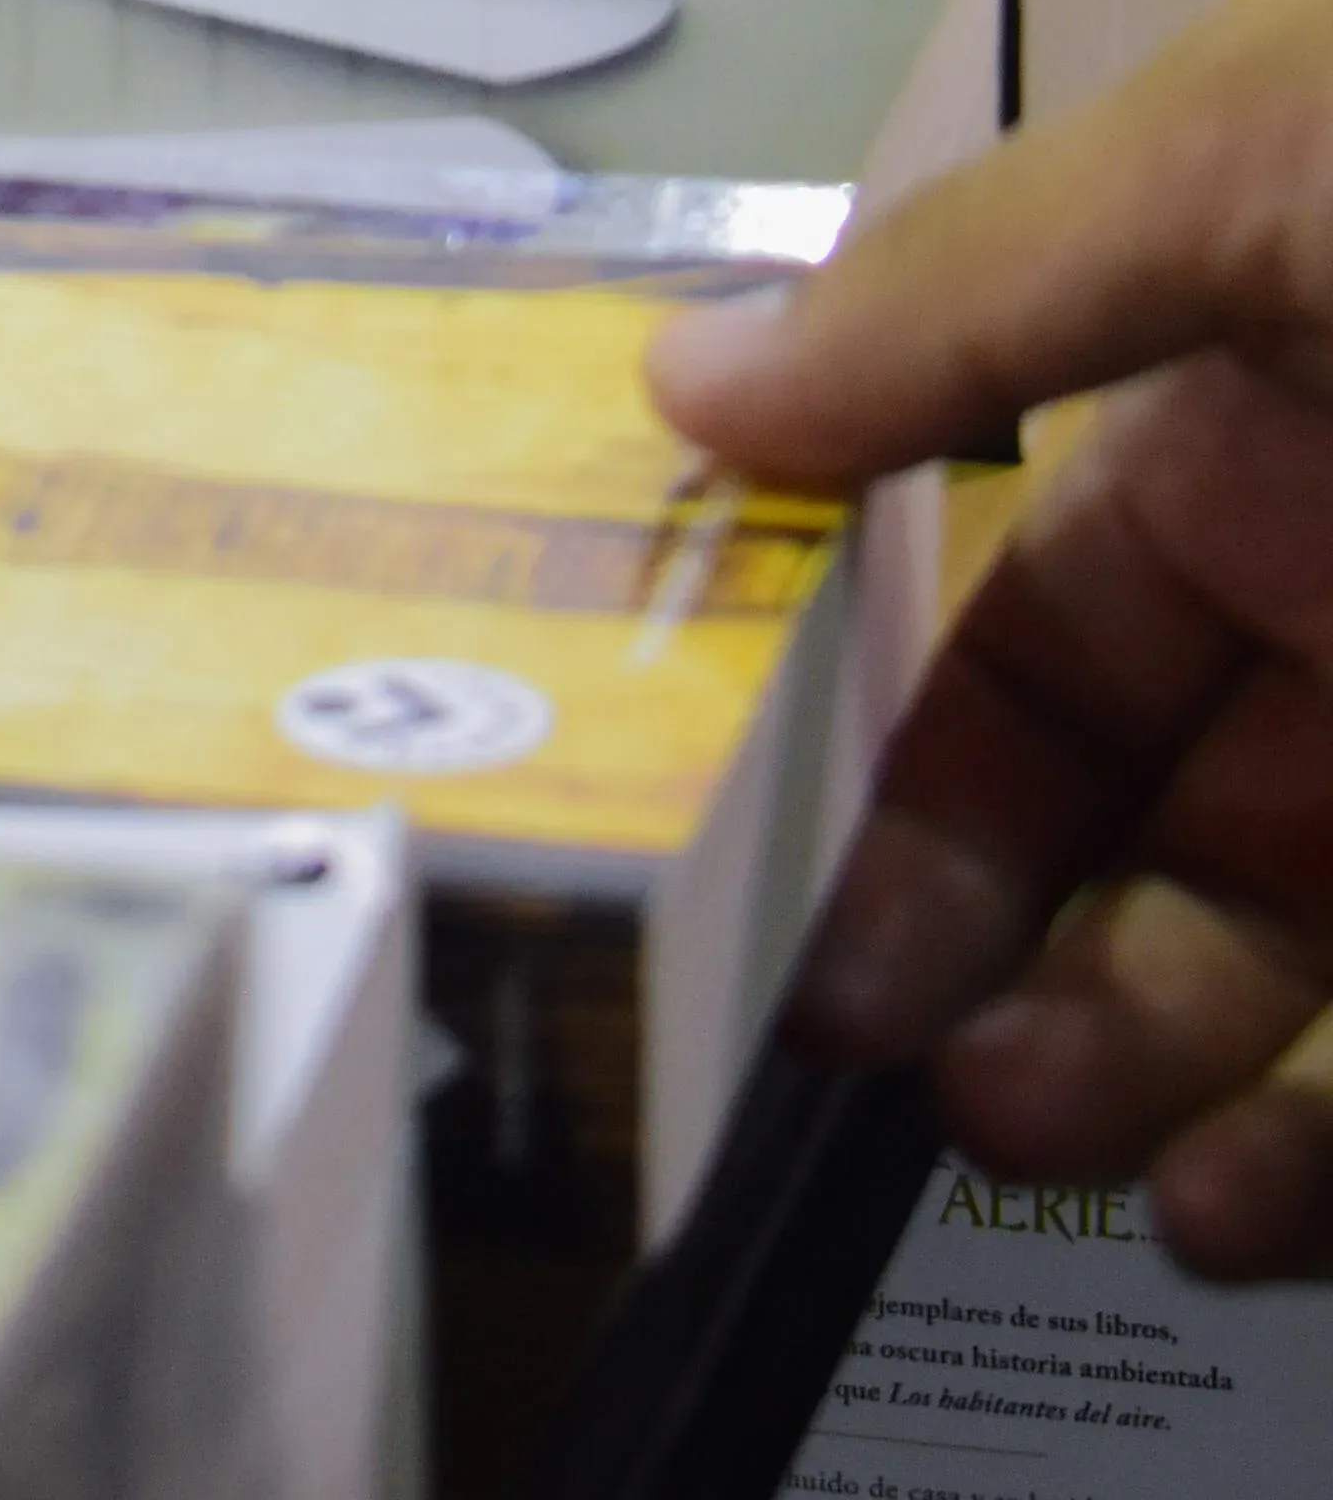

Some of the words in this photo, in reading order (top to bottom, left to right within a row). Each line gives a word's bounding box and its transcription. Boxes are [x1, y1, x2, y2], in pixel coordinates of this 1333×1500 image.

[1008, 1303, 1041, 1330] de
[1046, 1314, 1090, 1335] sus
[1093, 1310, 1180, 1347] libros,
[843, 1339, 874, 1358] na
[879, 1342, 964, 1367] oscura
[970, 1345, 1074, 1379] historia
[1078, 1358, 1235, 1393] ambientada
[833, 1382, 882, 1409] que
[887, 1381, 931, 1409] Los
[936, 1387, 1068, 1422] habitantes
[1073, 1400, 1113, 1426] del
[1116, 1405, 1173, 1432] aire.
[868, 1474, 900, 1499] de
